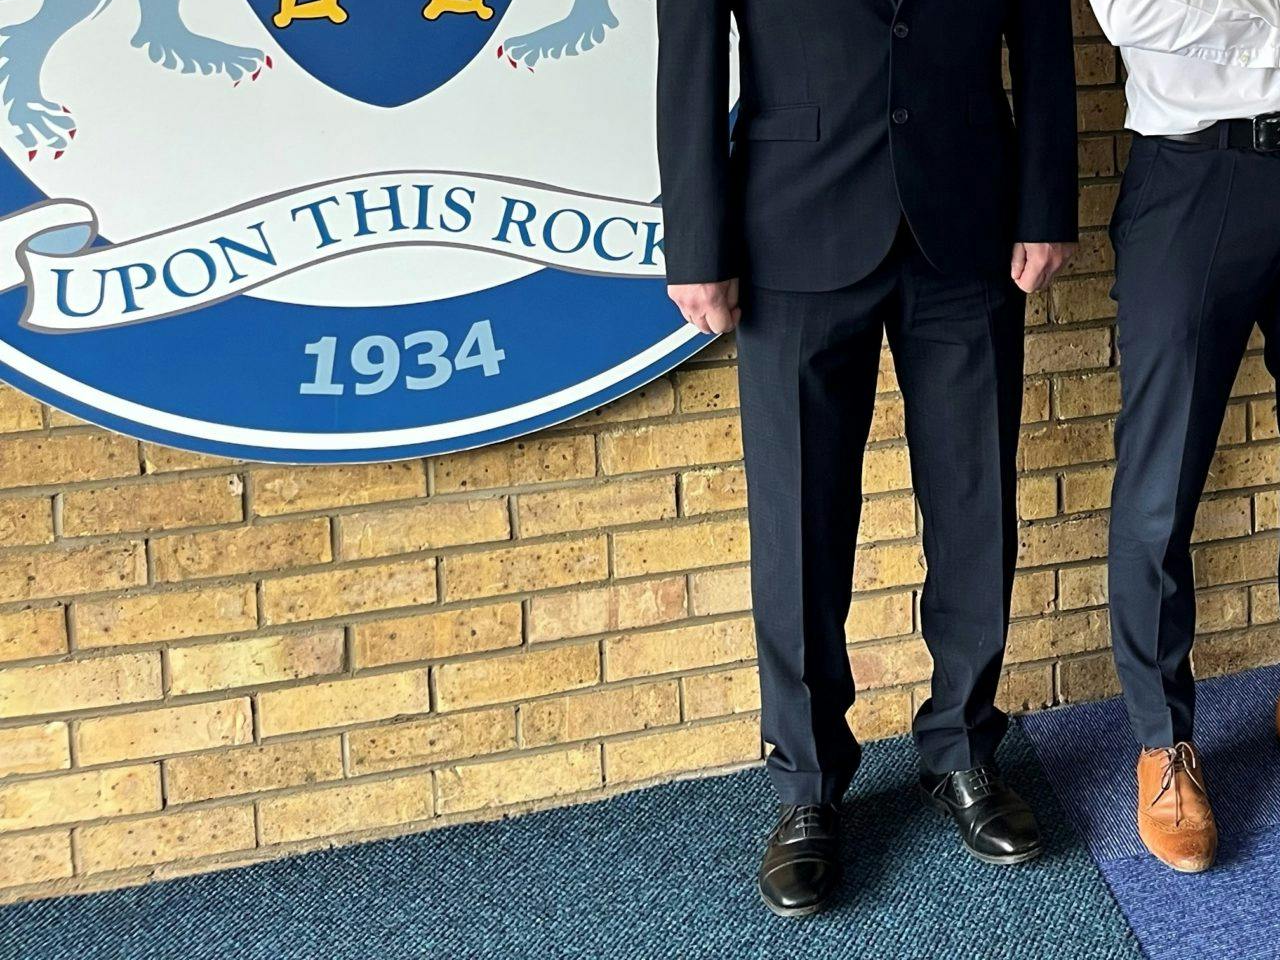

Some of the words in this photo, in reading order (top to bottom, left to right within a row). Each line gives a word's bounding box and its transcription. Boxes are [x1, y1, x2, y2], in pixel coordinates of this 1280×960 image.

[53, 223, 278, 317] UPON
[290, 184, 477, 250] THIS
[299, 319, 506, 397] 1934
